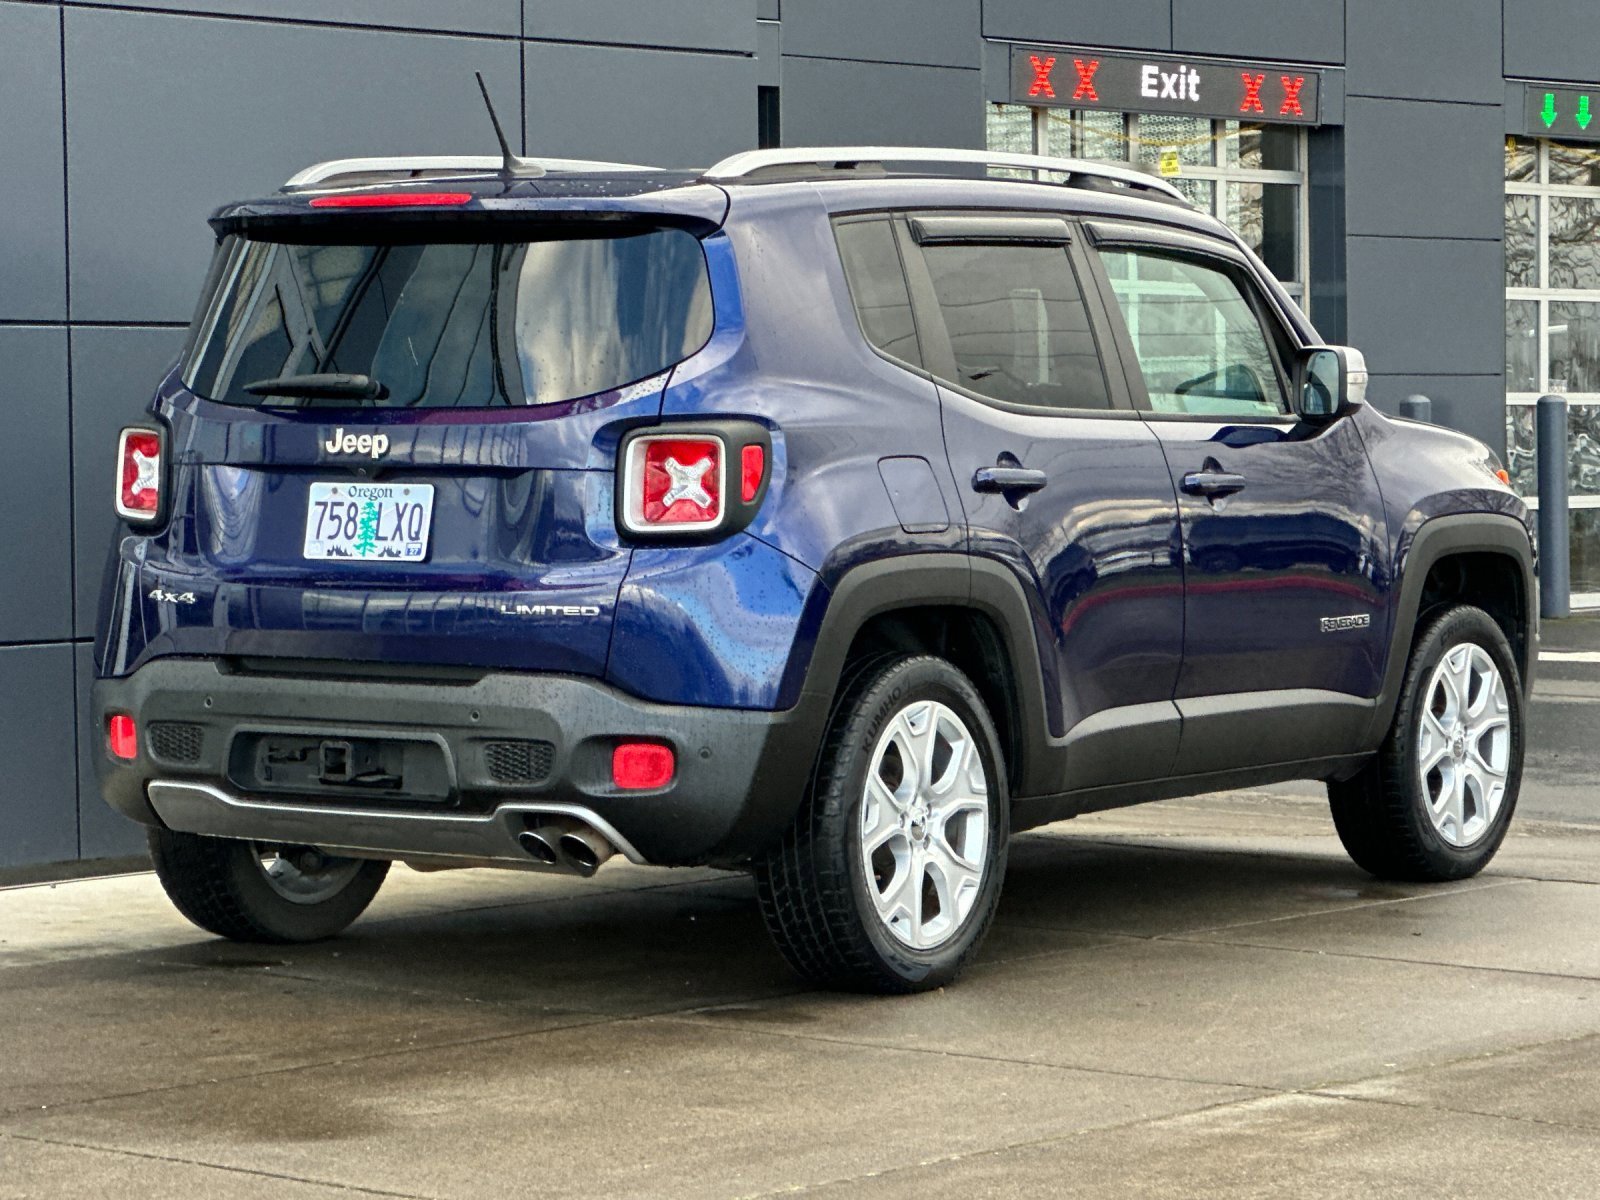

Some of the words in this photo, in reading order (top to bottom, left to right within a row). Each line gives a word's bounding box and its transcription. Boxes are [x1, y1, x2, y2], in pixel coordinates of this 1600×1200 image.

[1141, 64, 1200, 101] Exit
[325, 427, 389, 459] Jeep
[348, 485, 393, 501] Oregon
[314, 501, 359, 540] 758
[374, 502, 424, 541] LXQ
[148, 589, 196, 605] 4x4
[500, 604, 600, 616] LIMITED
[862, 687, 902, 753] KUMHO
